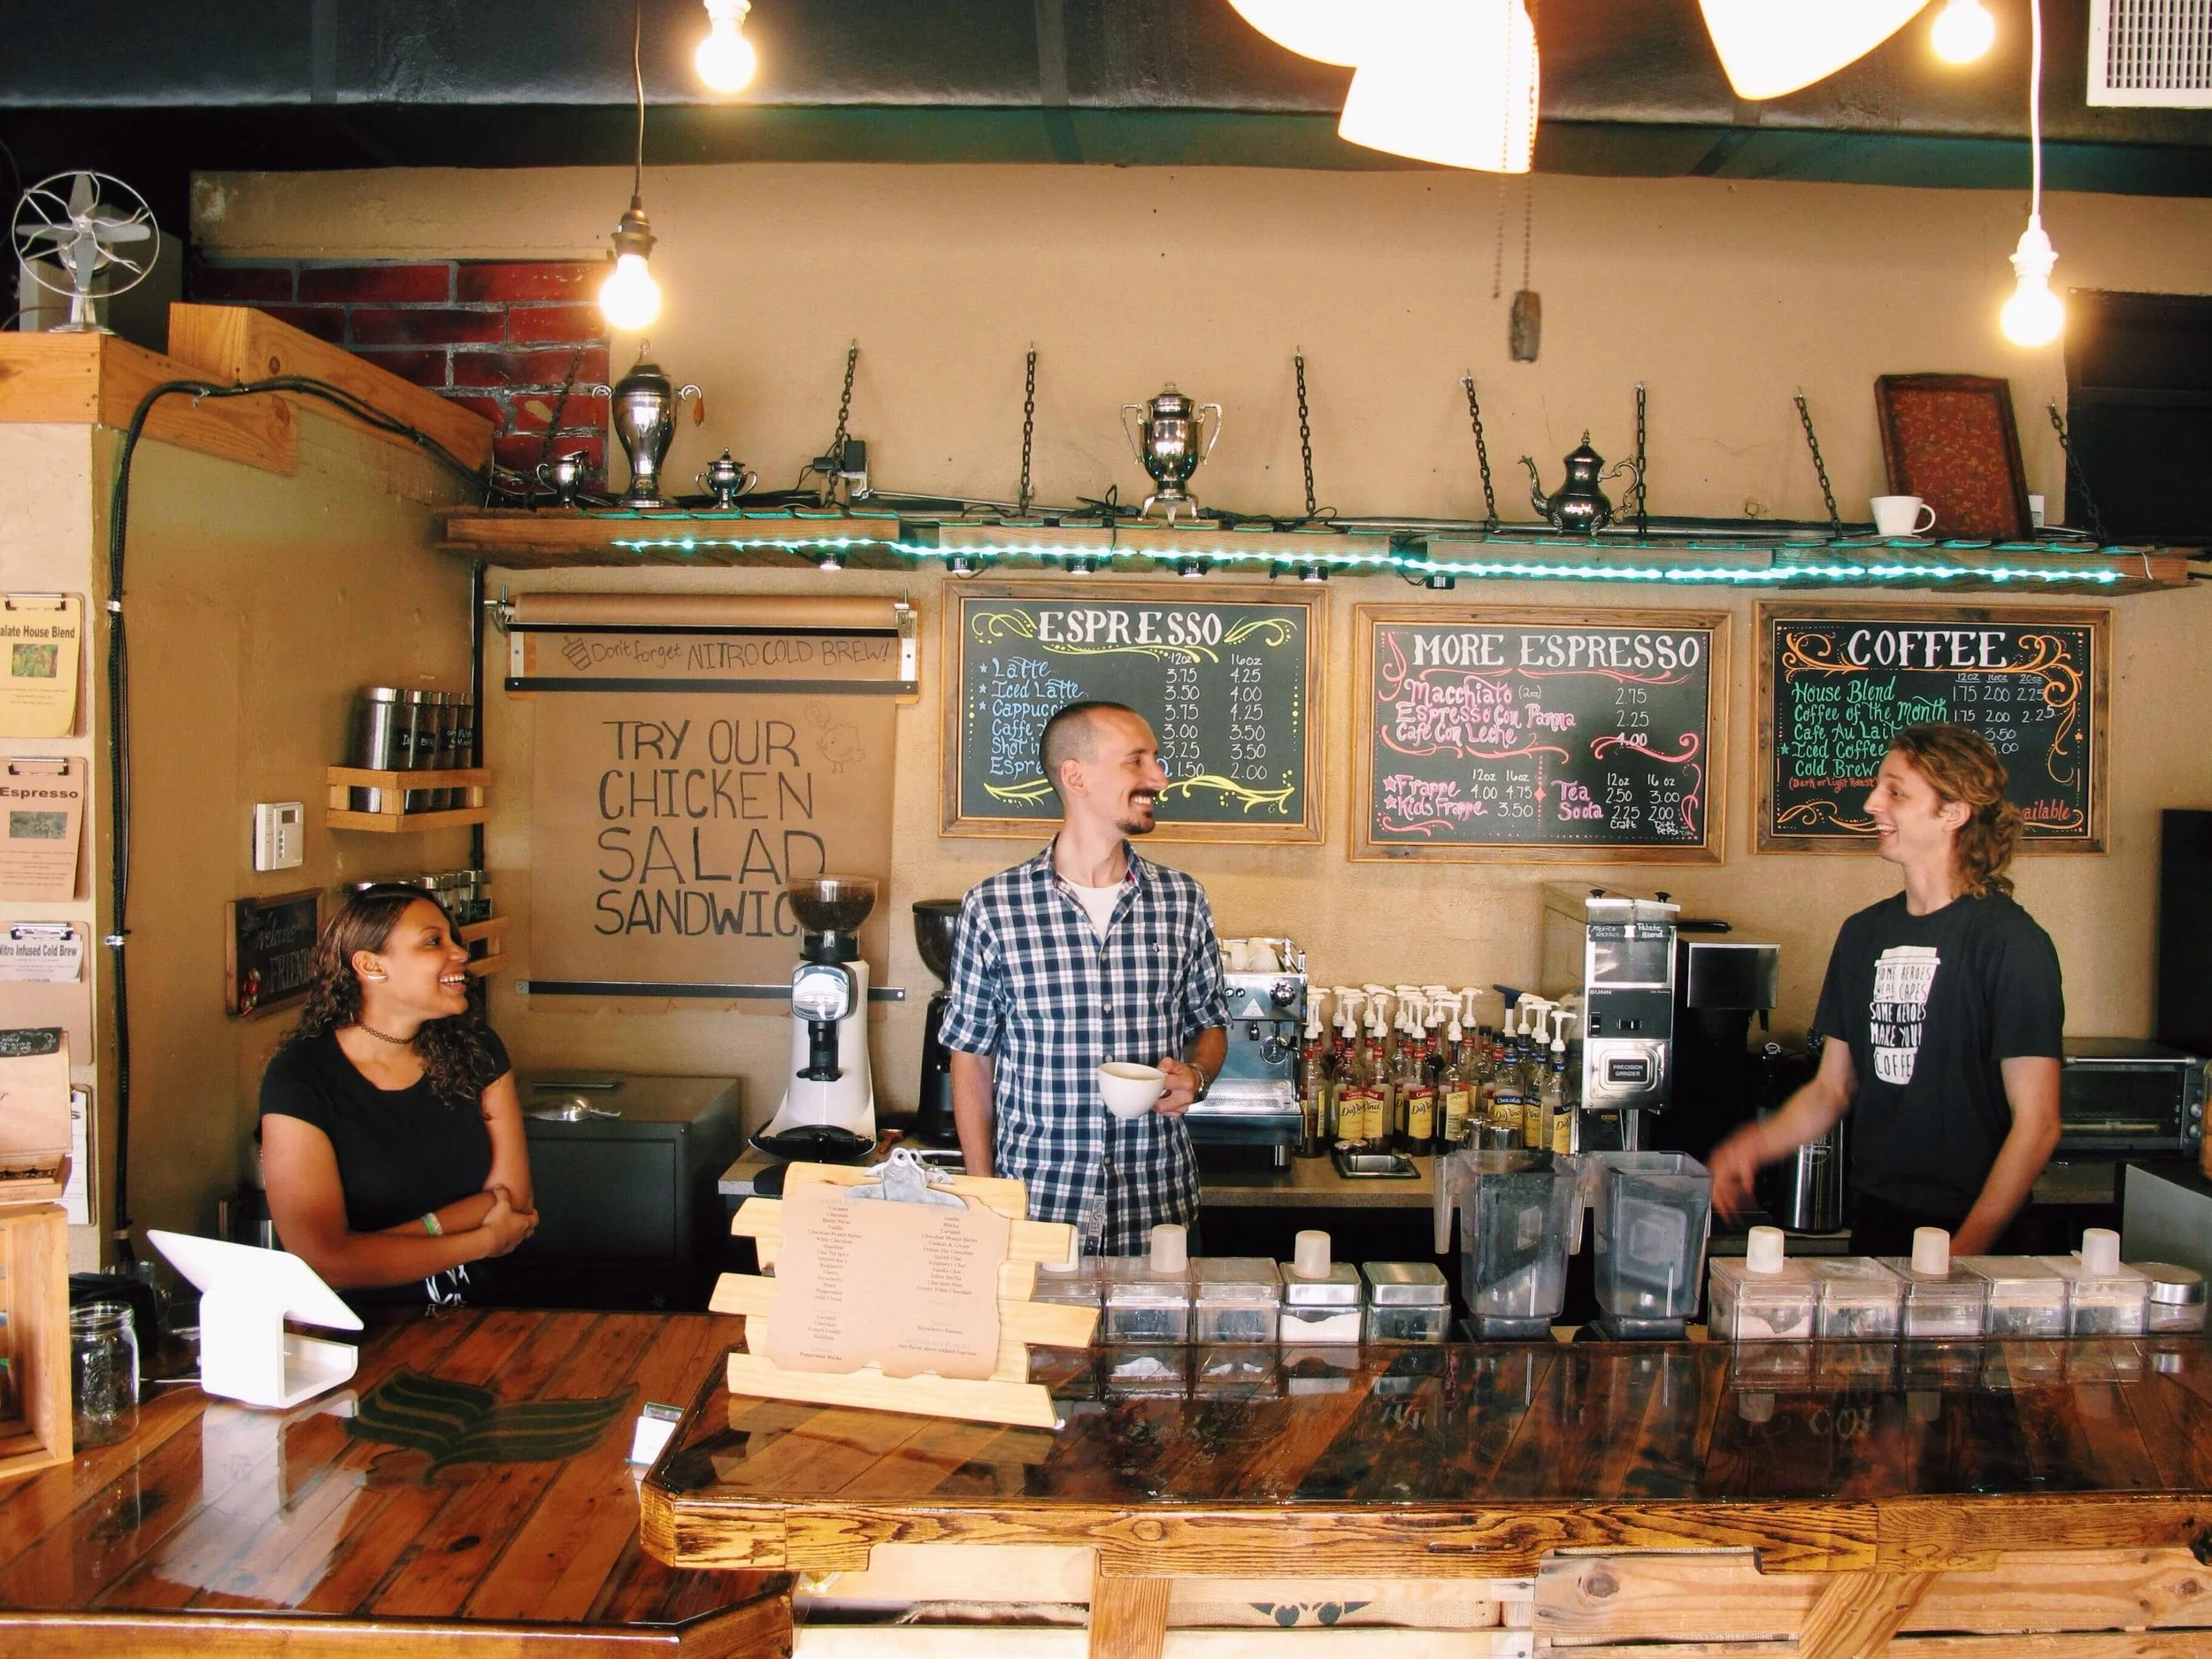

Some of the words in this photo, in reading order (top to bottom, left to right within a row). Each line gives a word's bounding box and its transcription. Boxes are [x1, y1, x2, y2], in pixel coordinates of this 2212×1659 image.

[0, 626, 21, 637] alate
[23, 625, 50, 638] House
[51, 626, 75, 639] Blend
[1038, 610, 1223, 646] ESPRESSO
[591, 639, 632, 664] Don't
[634, 640, 683, 668] forget
[687, 642, 759, 671] NITRO
[762, 641, 813, 665] COLD
[822, 641, 890, 666] BREW!
[1170, 653, 1193, 664] 12oz
[1231, 654, 1263, 666] 16oz
[1413, 633, 1505, 666] MORE
[1519, 634, 1701, 669] ESPRESSO
[1847, 629, 2008, 668] COFFEE
[992, 656, 1051, 680] Latte
[1166, 668, 1197, 683] 3.75
[1230, 668, 1261, 683] 4.25
[991, 680, 1031, 698] Iced
[1034, 678, 1085, 699] Latte
[1164, 685, 1200, 701] 3.50
[1230, 687, 1263, 702] 4.00
[1404, 675, 1513, 708] Macchiato
[1616, 687, 1647, 705] 2.75
[1792, 681, 1841, 703] House
[1847, 676, 1896, 703] Blend
[1953, 685, 1977, 702] 1.75
[992, 699, 1067, 720] Cappucci
[1164, 704, 1199, 721] 3.75
[1230, 703, 1263, 721] 4.25
[1395, 702, 1492, 726] Espresso
[1494, 704, 1522, 729] Con
[1525, 703, 1576, 733] Panna
[1617, 710, 1649, 727] 2.25
[1794, 704, 1840, 726] Coffee
[1846, 703, 1862, 726] of
[1862, 702, 1892, 722] the
[1955, 710, 1976, 722] 1.75
[2022, 705, 2055, 723] 2.25
[992, 718, 1033, 739] Caffe
[1163, 724, 1198, 740] 3.00
[1230, 725, 1265, 741] 3.50
[1434, 722, 1463, 748] Con
[1465, 723, 1517, 749] Leche
[1617, 732, 1647, 747] 4.00
[1794, 723, 1826, 744] Cafe
[1832, 723, 1855, 741] Au
[1860, 720, 1902, 739] Lait
[603, 718, 693, 761] TRY
[709, 718, 800, 766] OUR
[991, 736, 1028, 759] Shot
[1164, 741, 1200, 759] 3.25
[1230, 743, 1266, 760] 3.50
[1792, 739, 1829, 759] Iced
[1836, 741, 1889, 759] Coffee
[990, 757, 1044, 780] Espre
[1178, 761, 1204, 778] 1.50
[1231, 763, 1267, 780] 2.00
[1472, 768, 1497, 781] 12oz
[1506, 770, 1530, 782] 16oz
[1607, 772, 1630, 786] 12oz
[1795, 759, 1827, 777] Cold
[1832, 759, 1879, 779] Brew
[0, 787, 79, 799] Espresso
[598, 767, 815, 821] CHICKEN
[1395, 774, 1461, 801] Frappe
[1471, 784, 1498, 800] 4.00
[1506, 786, 1532, 799] 4.75
[1550, 780, 1591, 802] Tea
[1605, 787, 1632, 803] 2.50
[1649, 790, 1680, 803] 3.00
[1398, 795, 1433, 820] Kids
[1435, 797, 1488, 821] Frappe
[1497, 802, 1533, 818] 3.50
[1557, 802, 1604, 821] Soda
[1611, 806, 1640, 820] 2.25
[1647, 806, 1674, 821] 2.00
[2024, 798, 2070, 820] ailable
[1610, 819, 1638, 830] Craft
[596, 826, 826, 885] SALAD
[594, 888, 798, 938] SANDWIC
[15, 944, 42, 956] Infused
[42, 944, 58, 956] Cold
[59, 945, 78, 956] Brew
[1877, 966, 1896, 980] SOME
[1899, 983, 1927, 1001] CAPES
[1870, 1002, 1893, 1023] SOME
[1870, 1022, 1896, 1047] MAKE
